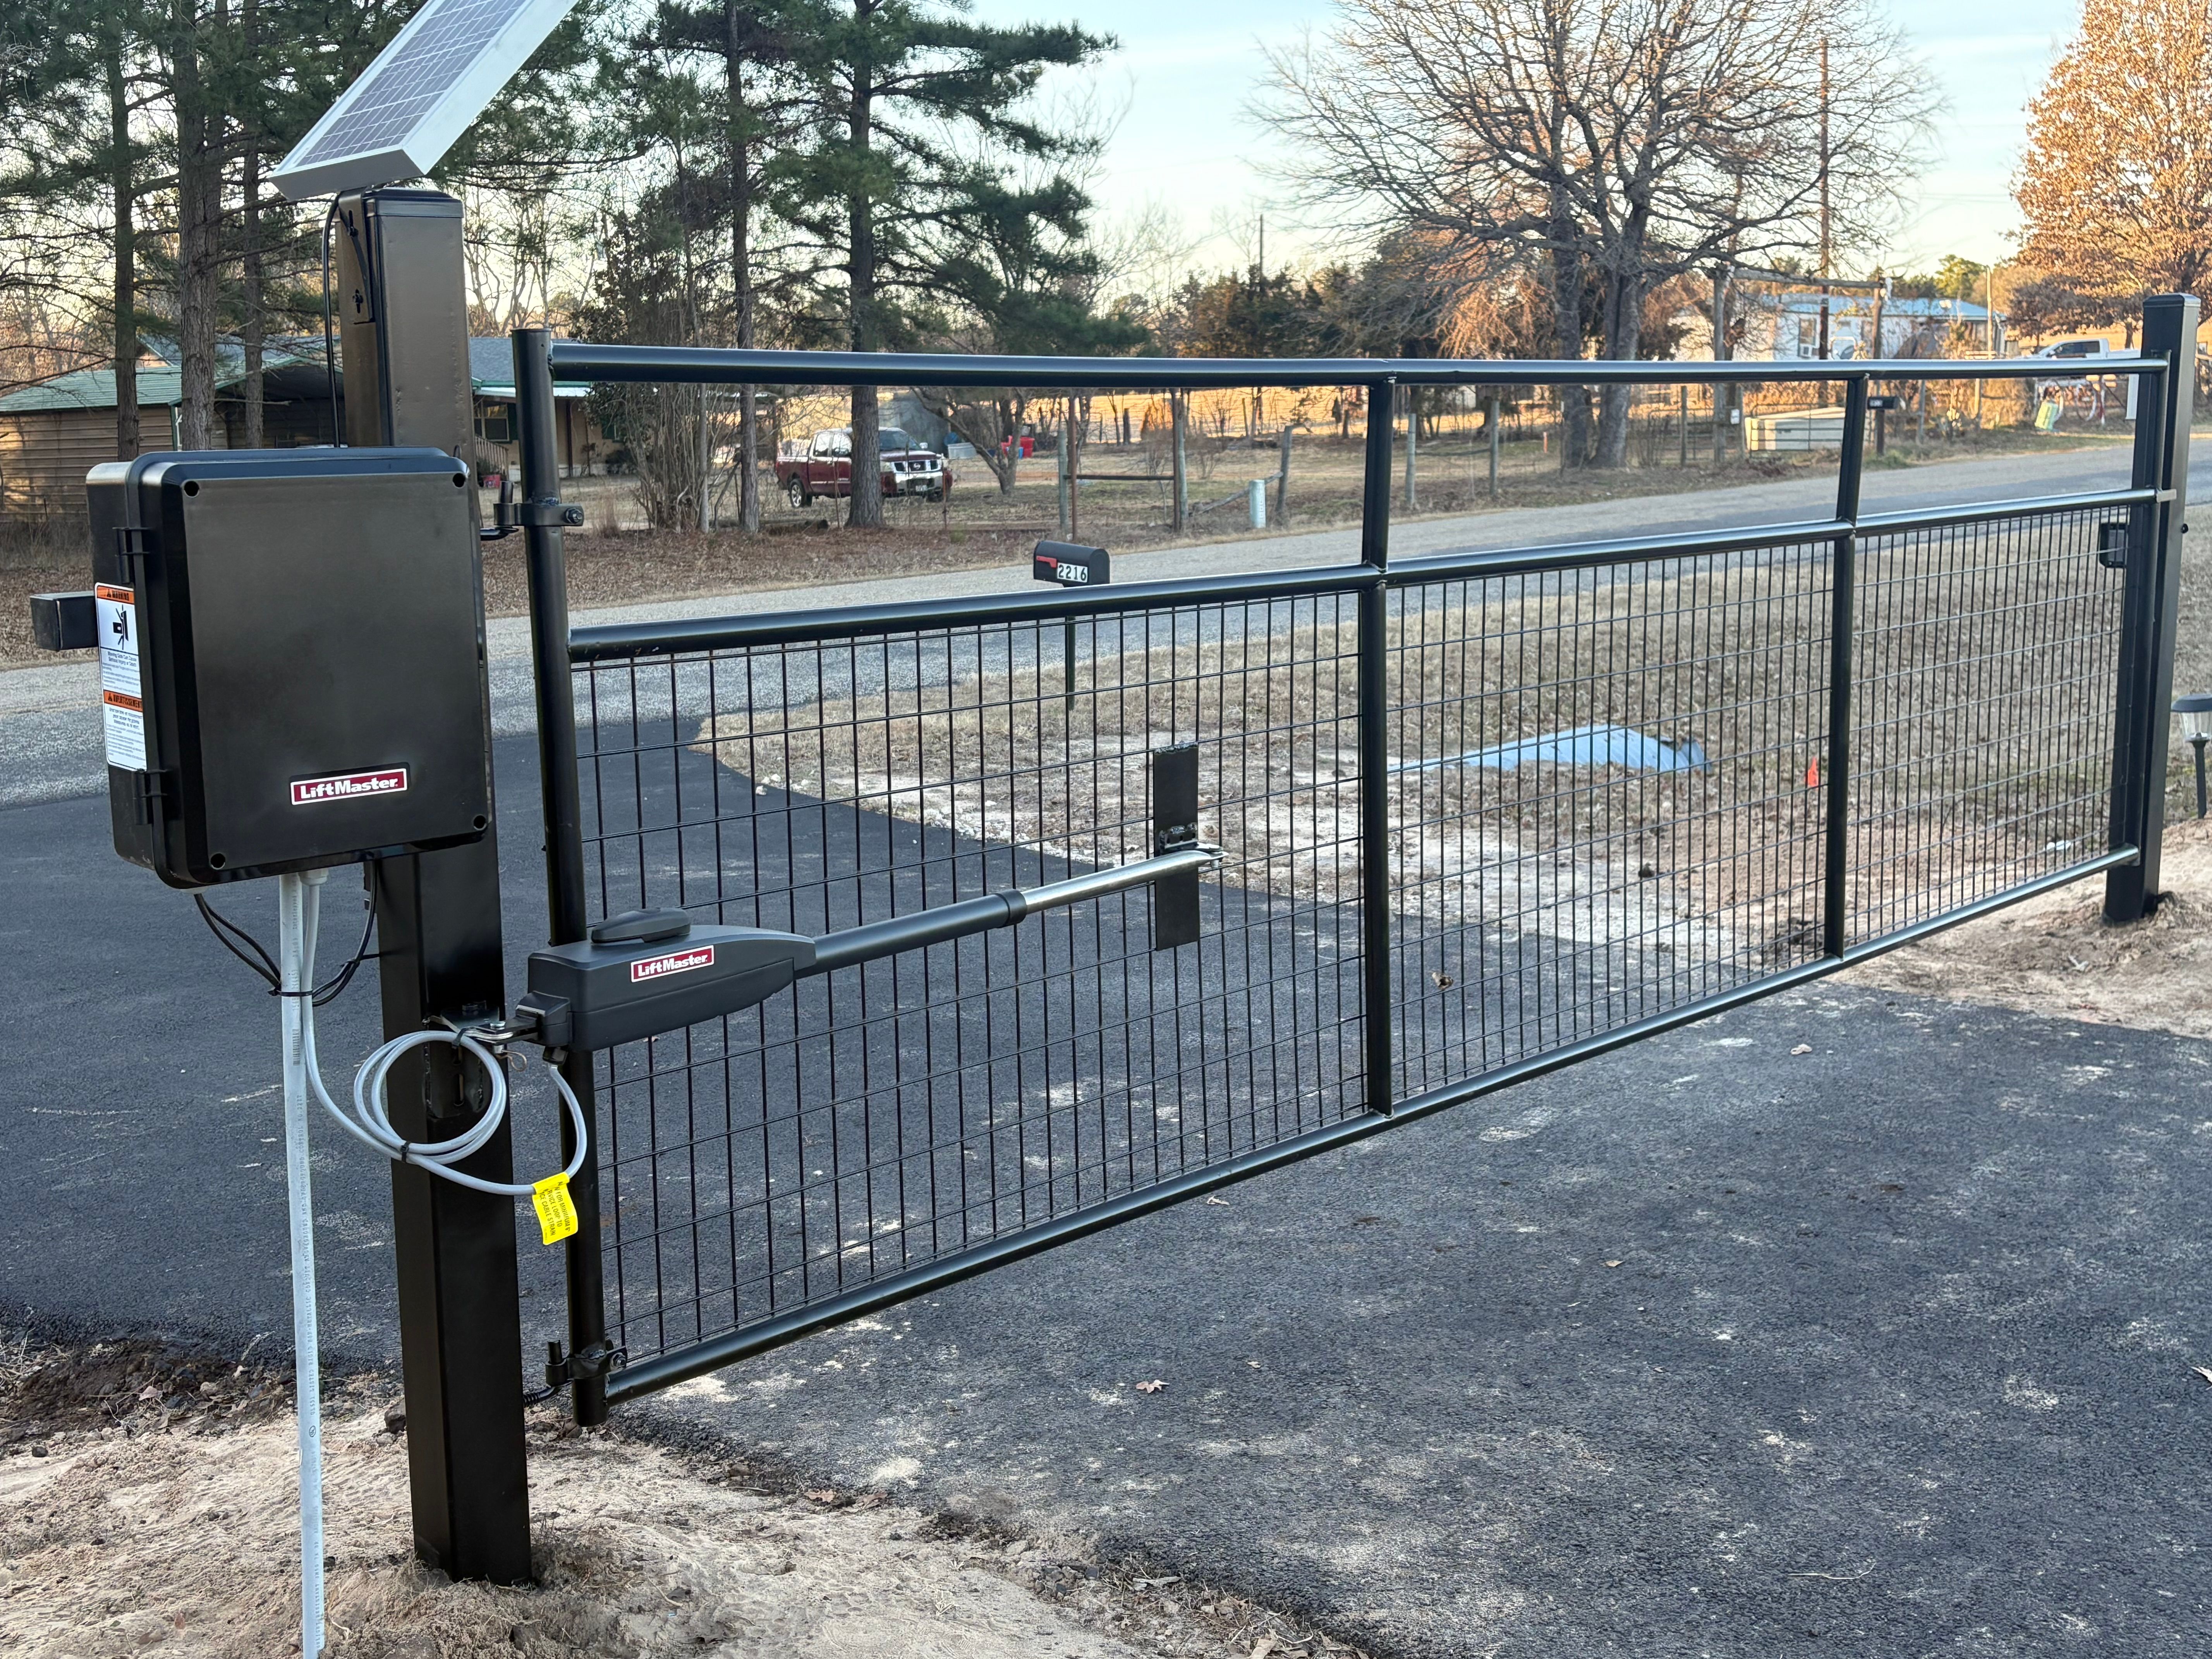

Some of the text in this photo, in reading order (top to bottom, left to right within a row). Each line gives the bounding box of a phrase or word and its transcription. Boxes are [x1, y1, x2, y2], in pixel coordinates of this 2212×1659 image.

[1058, 564, 1086, 581] 2216
[301, 777, 398, 799] LiftMaster
[638, 954, 708, 977] LiftMaster
[542, 1201, 551, 1217] CABLE
[547, 1218, 556, 1236] STRAIN
[552, 1205, 561, 1219] LOOP
